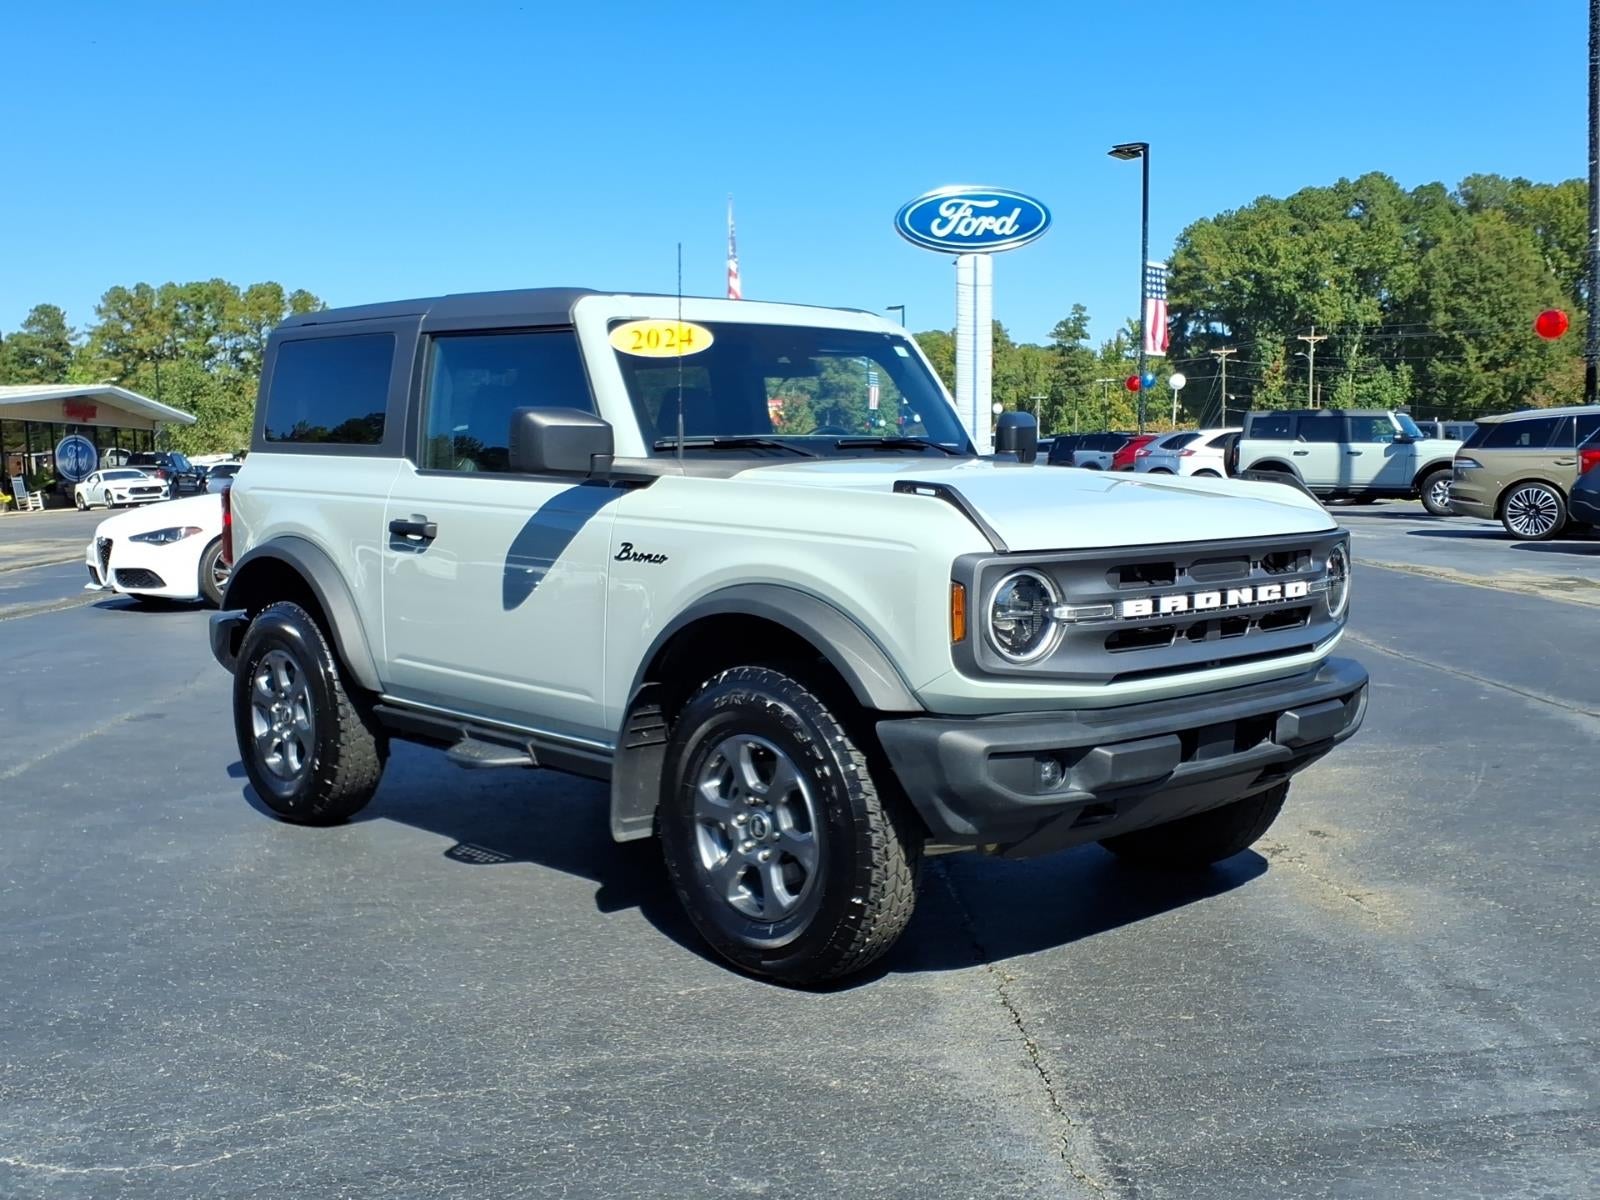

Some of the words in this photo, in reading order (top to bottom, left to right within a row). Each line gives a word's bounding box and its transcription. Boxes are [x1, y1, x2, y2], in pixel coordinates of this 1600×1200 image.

[930, 198, 1021, 238] Ford
[631, 327, 693, 350] 2024
[614, 542, 668, 564] Bronco
[1123, 581, 1307, 617] BRONCO
